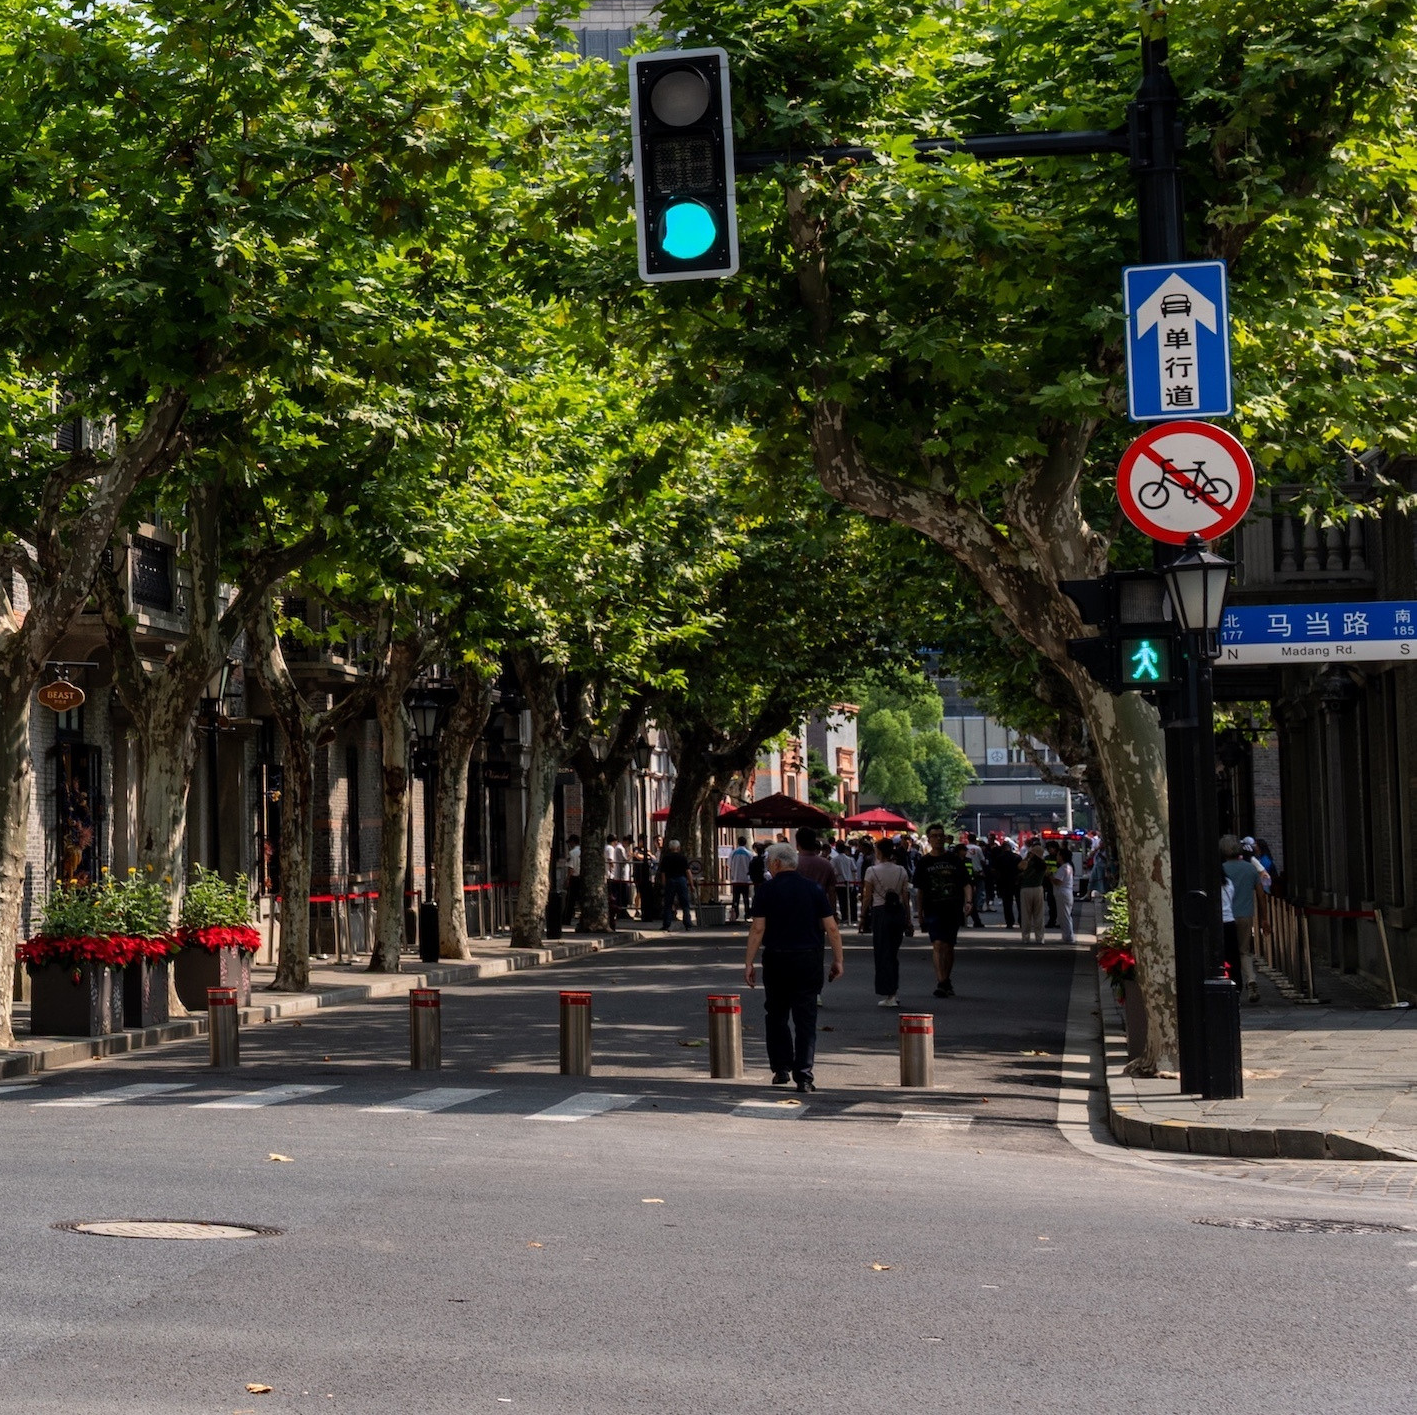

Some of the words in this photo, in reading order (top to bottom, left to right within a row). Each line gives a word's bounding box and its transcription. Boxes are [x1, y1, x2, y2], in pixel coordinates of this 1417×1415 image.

[1163, 328, 1196, 407] 单行道
[1224, 614, 1240, 628] 北
[1395, 609, 1411, 624] 南
[1267, 611, 1370, 637] 马当路
[1222, 630, 1244, 641] 177
[1393, 626, 1415, 636] 185
[1227, 649, 1239, 660] N
[1281, 646, 1330, 658] Madang
[1335, 645, 1357, 655] Rd.
[1400, 643, 1411, 655] S
[46, 690, 75, 700] BEAST
